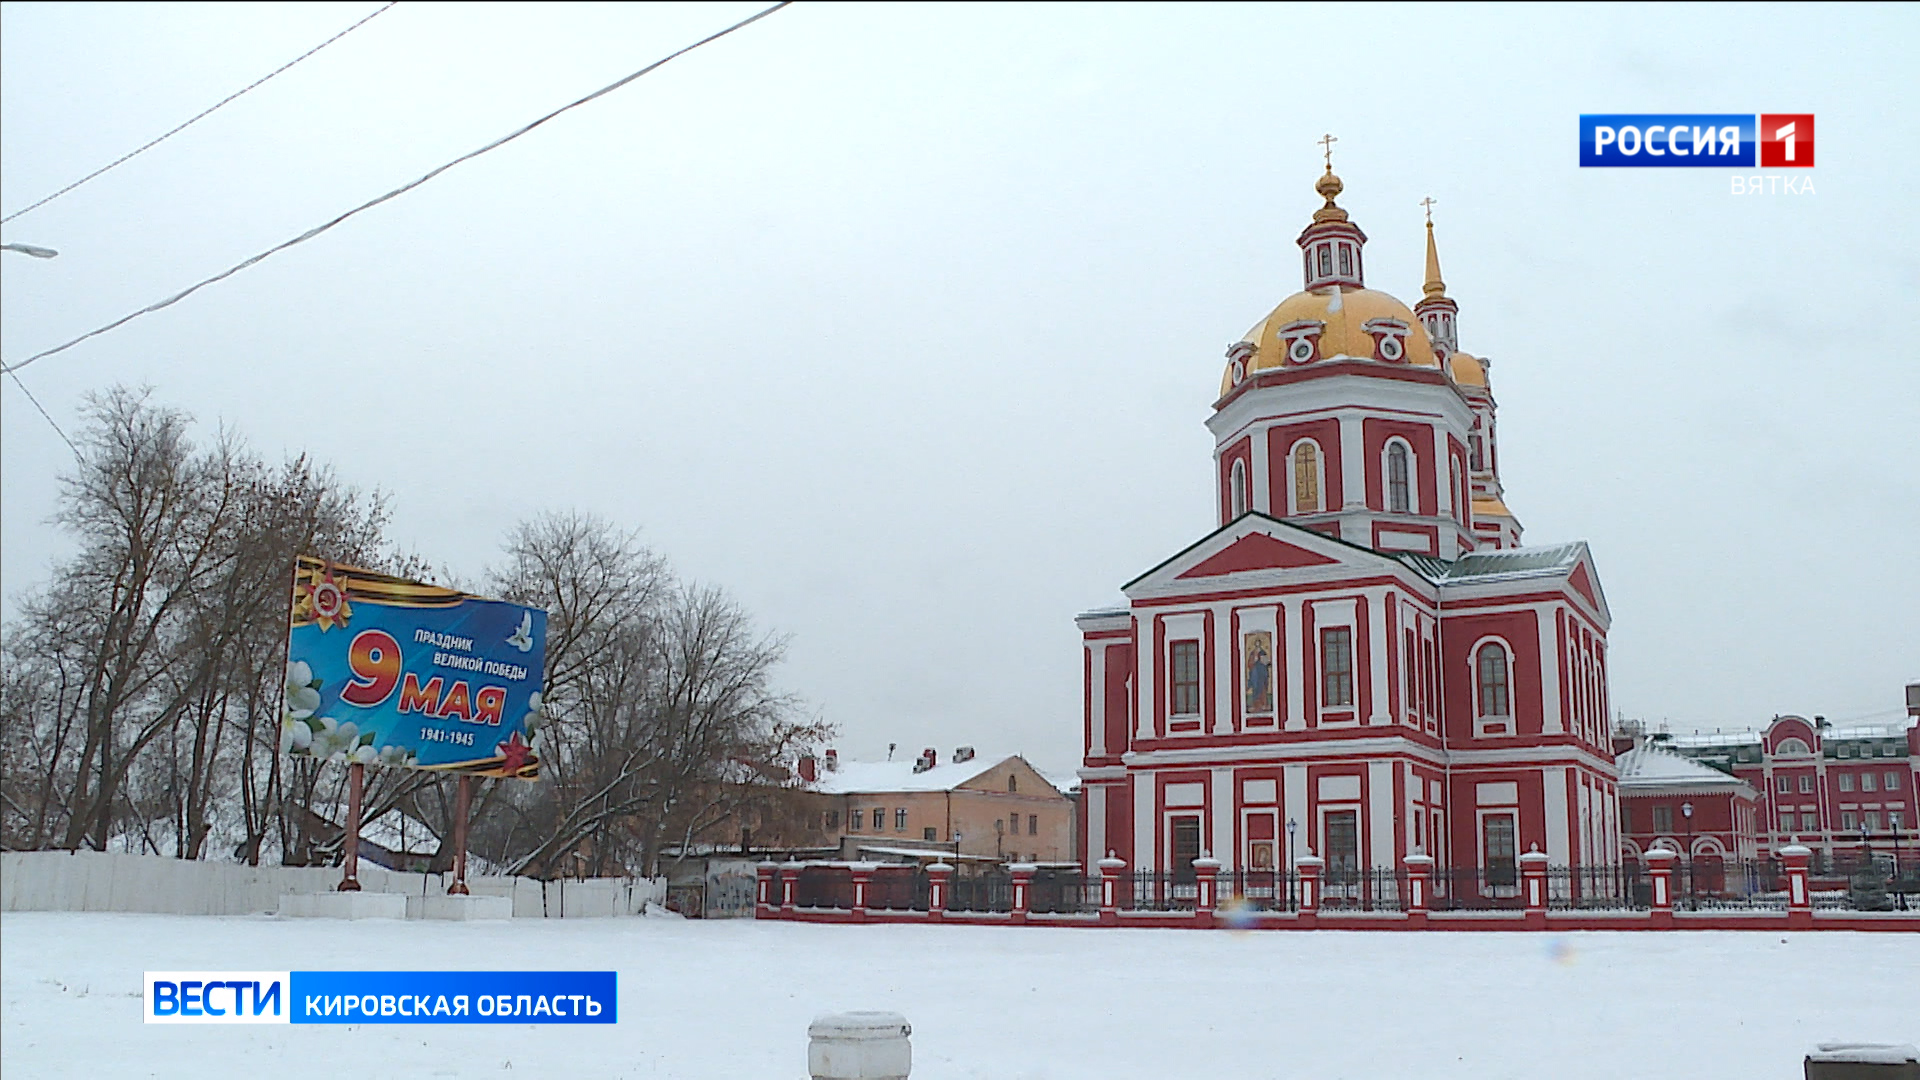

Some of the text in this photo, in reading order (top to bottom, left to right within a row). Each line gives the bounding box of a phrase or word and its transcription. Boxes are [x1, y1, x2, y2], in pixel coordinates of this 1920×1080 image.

[414, 629, 473, 652] ПРАЗДНИК
[340, 630, 508, 726] 9 МАЯ
[433, 652, 528, 680] ВЕЛИКОЙ ПОБЕДЫ
[420, 727, 475, 746] 1941-1945
